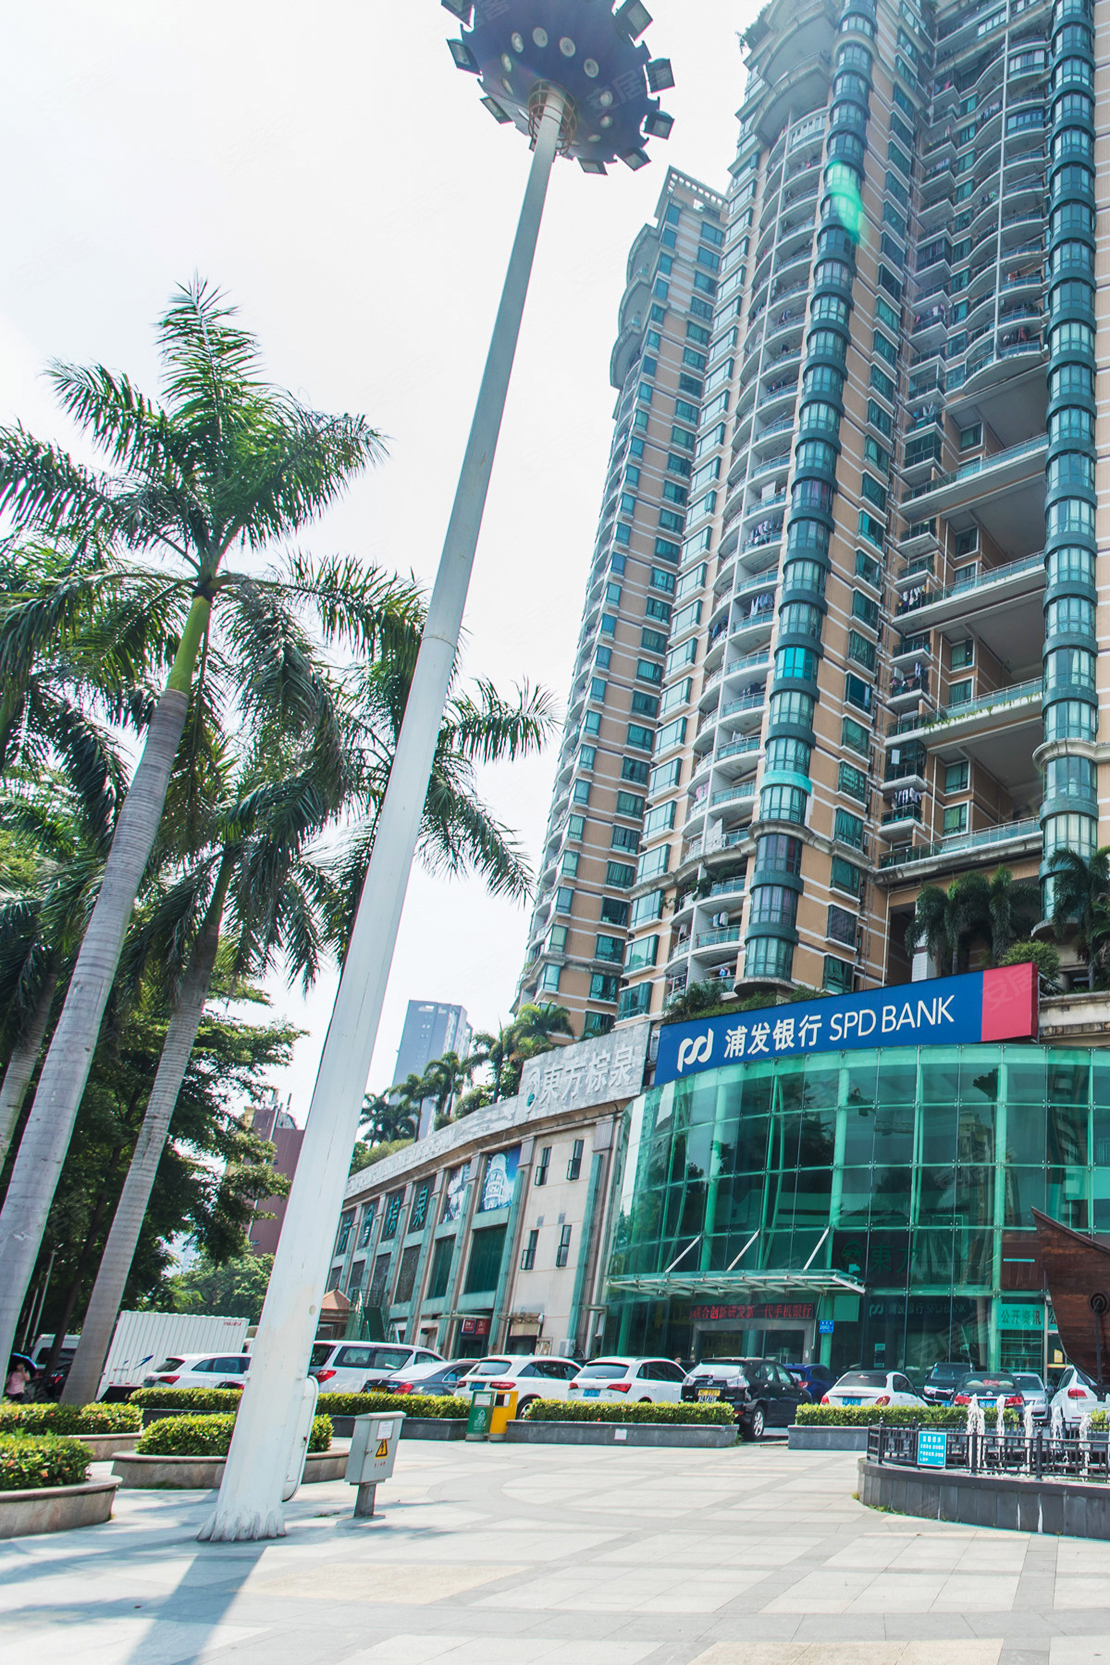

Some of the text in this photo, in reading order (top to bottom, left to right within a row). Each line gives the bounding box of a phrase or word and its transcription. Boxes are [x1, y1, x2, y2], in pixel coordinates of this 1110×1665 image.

[724, 995, 955, 1059] 浦发银行 SPD BANK
[540, 1044, 634, 1104] 東方棕泉
[1000, 1308, 1041, 1326] 公开资讯
